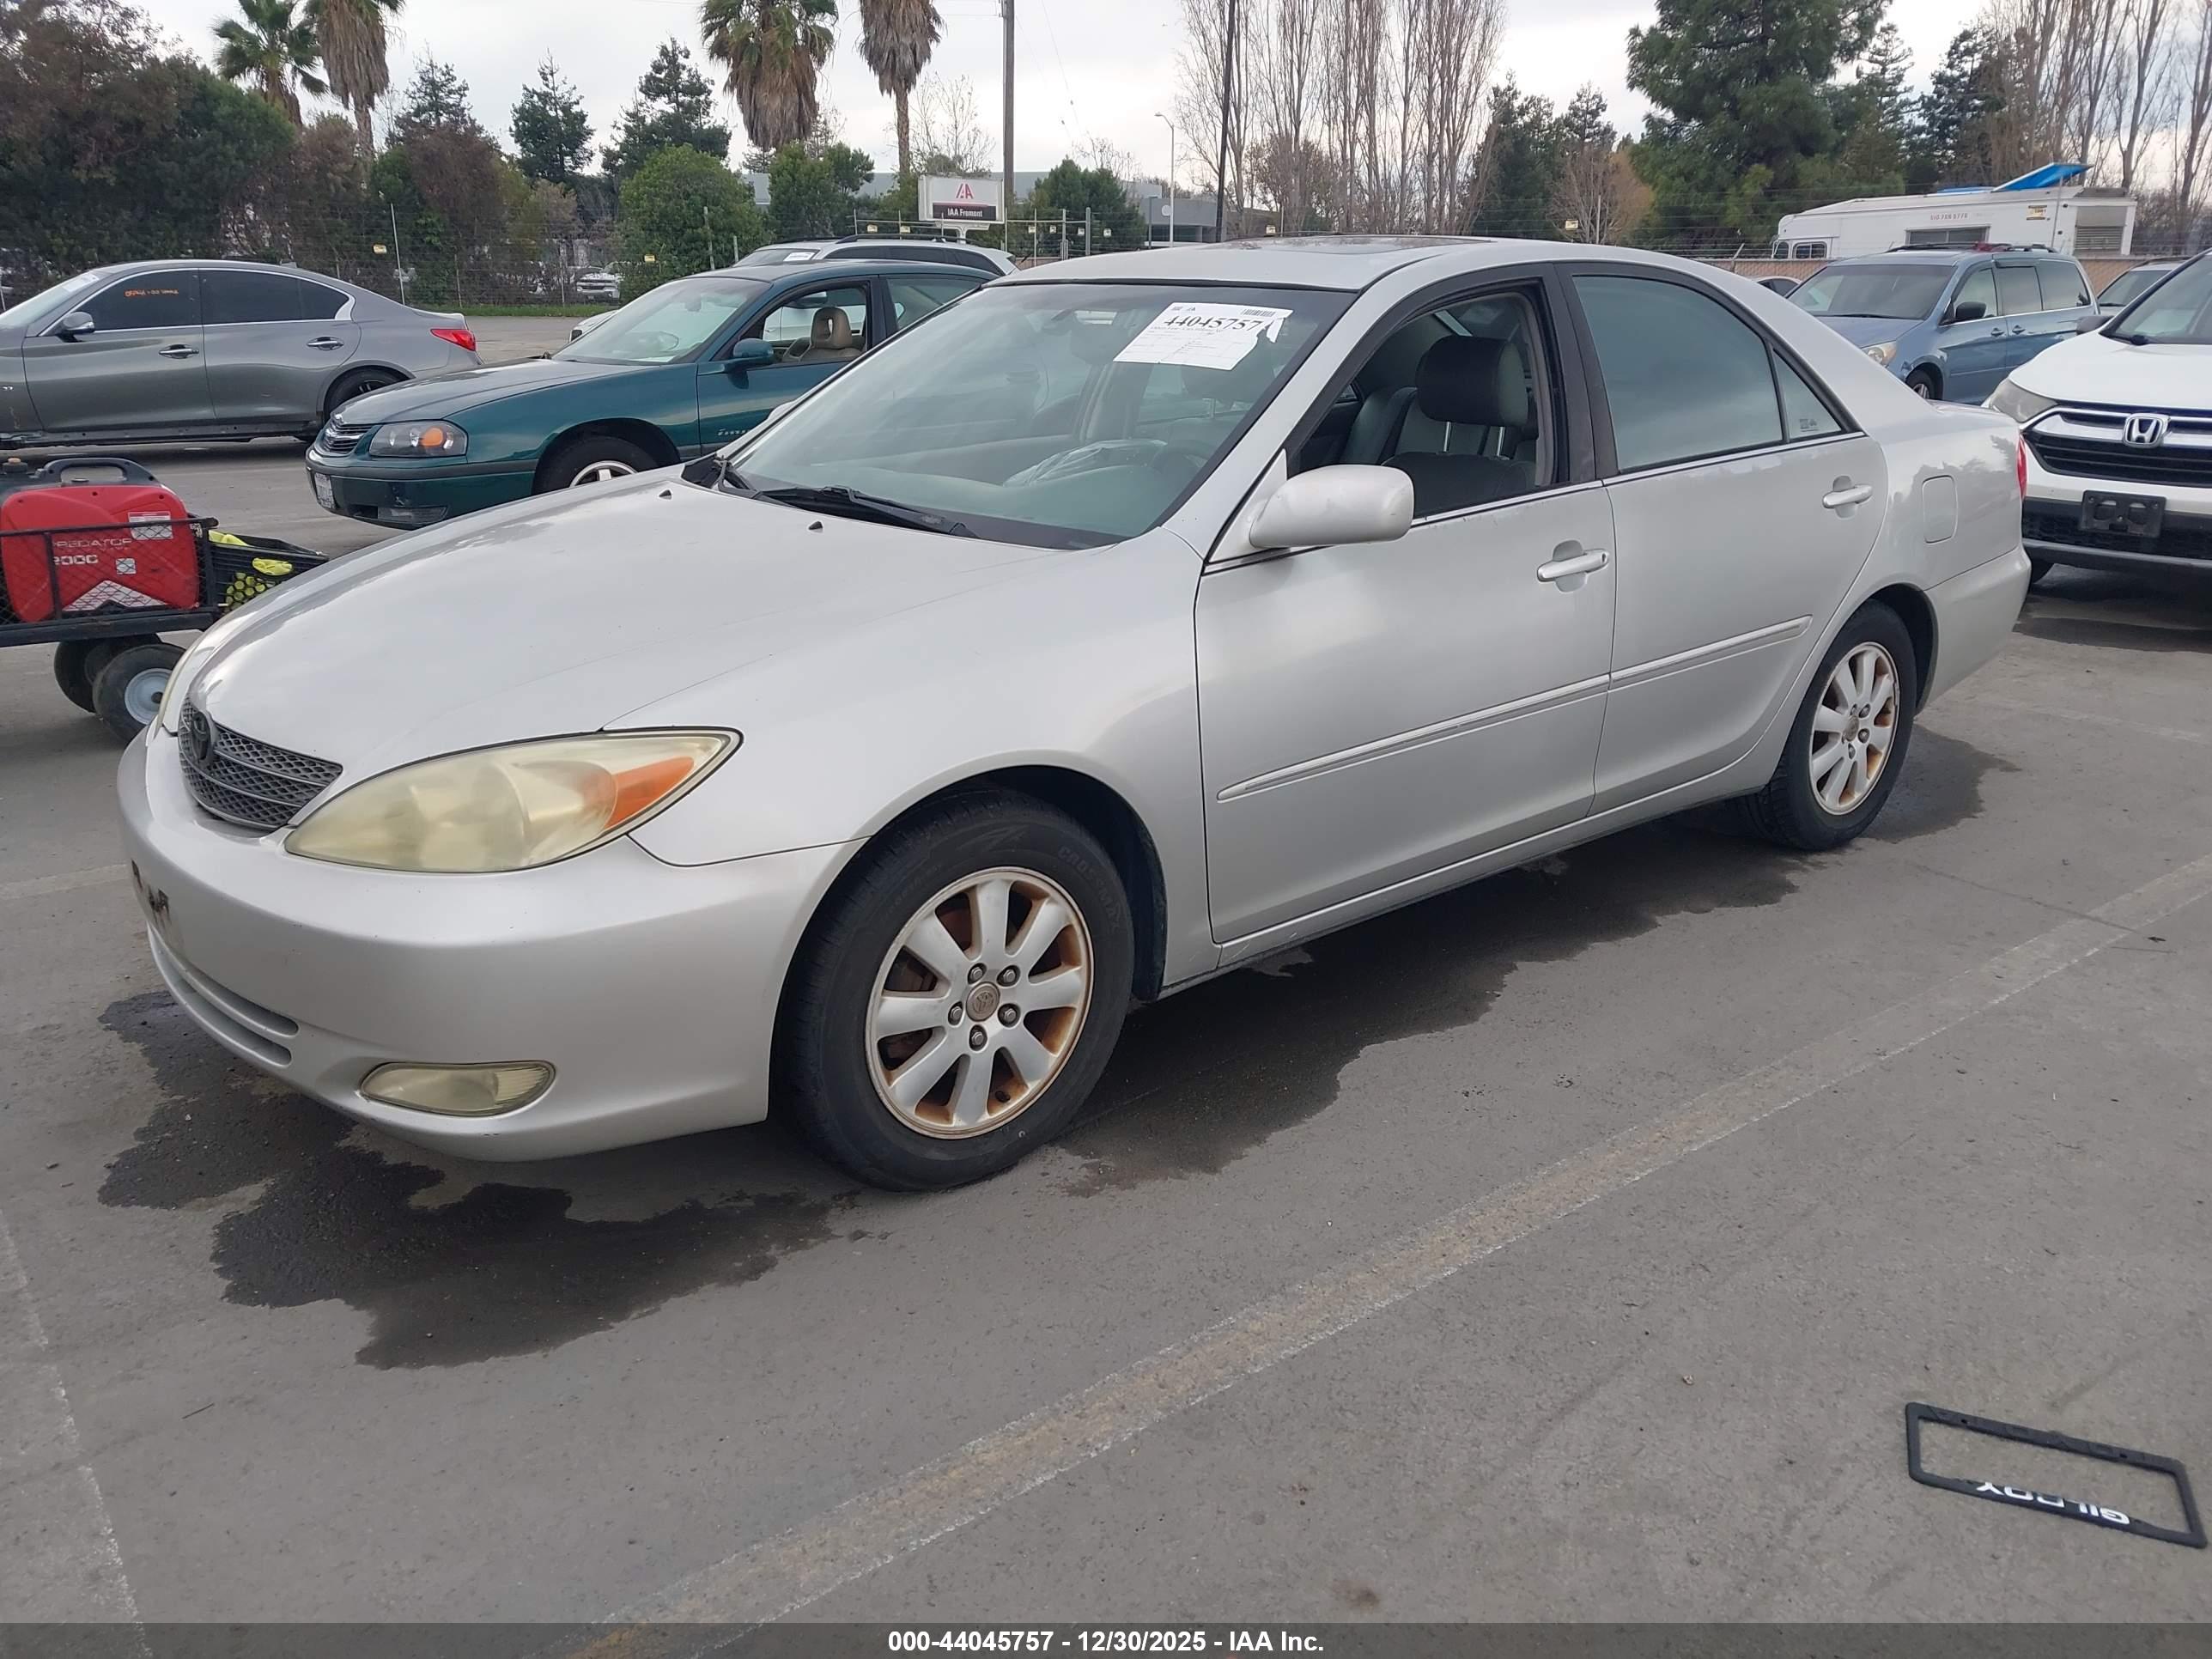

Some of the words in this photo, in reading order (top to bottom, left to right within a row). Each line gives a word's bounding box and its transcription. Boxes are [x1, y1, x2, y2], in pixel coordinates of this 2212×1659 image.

[947, 208, 959, 216] IAA
[960, 209, 983, 217] Fremont
[1163, 315, 1265, 331] 44045757
[1976, 1481, 2130, 1525] GILROY
